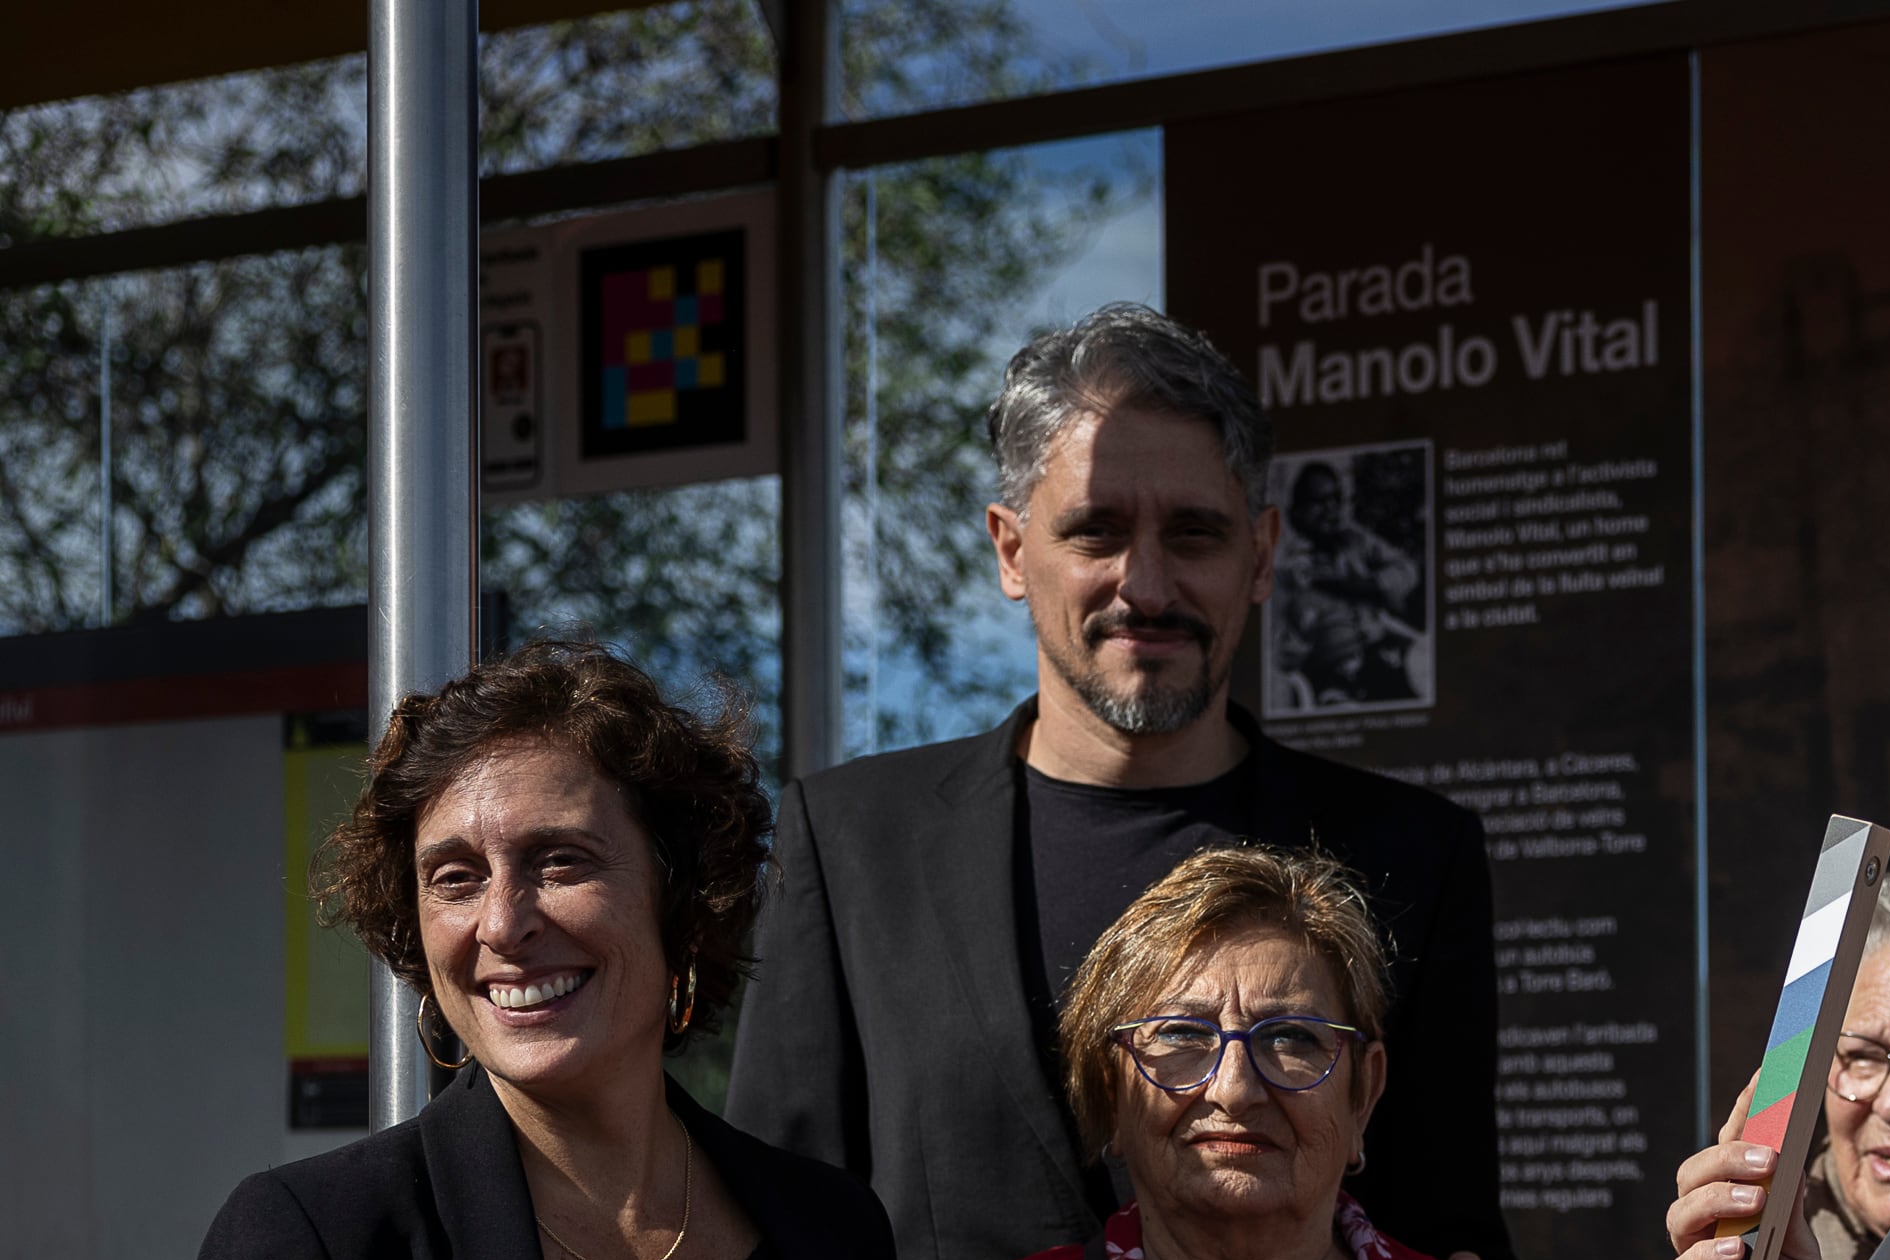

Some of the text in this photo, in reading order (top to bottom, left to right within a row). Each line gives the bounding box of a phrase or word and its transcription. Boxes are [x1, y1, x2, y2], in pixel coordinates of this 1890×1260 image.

[1258, 243, 1473, 327] Parada
[1259, 299, 1660, 410] Manolo Vital
